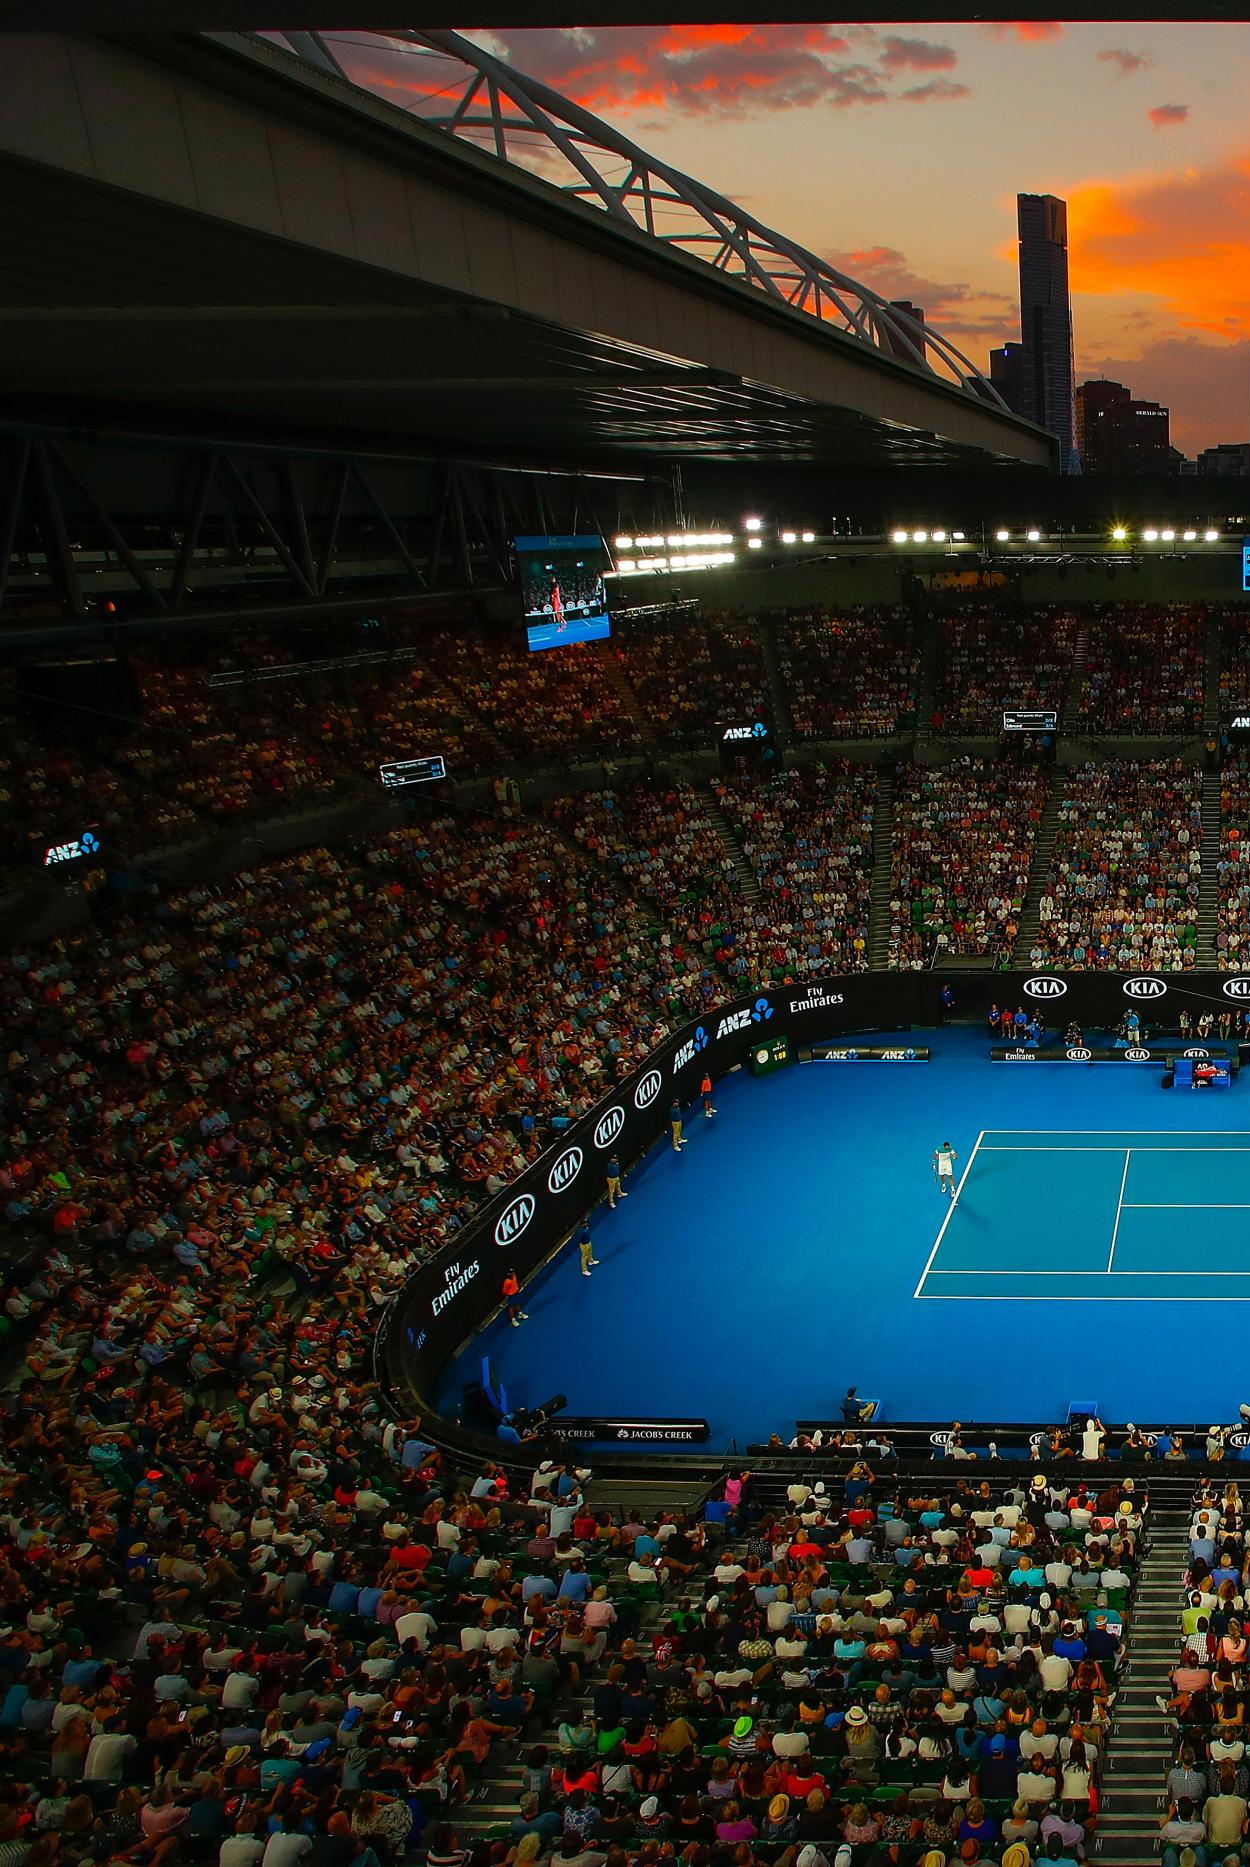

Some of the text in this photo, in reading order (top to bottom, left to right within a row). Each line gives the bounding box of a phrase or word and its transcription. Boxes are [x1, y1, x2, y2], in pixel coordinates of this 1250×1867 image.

[723, 726, 752, 740] ANZ
[44, 841, 82, 866] ANZ
[807, 987, 823, 997] Fly
[1030, 980, 1060, 994] KIA
[1130, 980, 1160, 994] KIA
[790, 993, 844, 1013] Emirates
[716, 1008, 752, 1040] ANZ
[673, 1038, 695, 1075] ANZ
[825, 1050, 847, 1060] ANZ
[881, 1050, 904, 1060] ANZ
[1005, 1052, 1035, 1060] Emirates
[1069, 1050, 1088, 1058] KIA
[1130, 1050, 1148, 1058] KIA
[638, 1075, 658, 1105] KIA
[598, 1112, 620, 1144] KIA
[554, 1154, 578, 1189] KIA
[501, 1201, 530, 1241] KIA
[444, 1262, 460, 1282] Fly
[432, 1260, 480, 1316] Emirates
[568, 1430, 596, 1438] CREEK
[630, 1430, 692, 1439] JACOB'S CREEK
